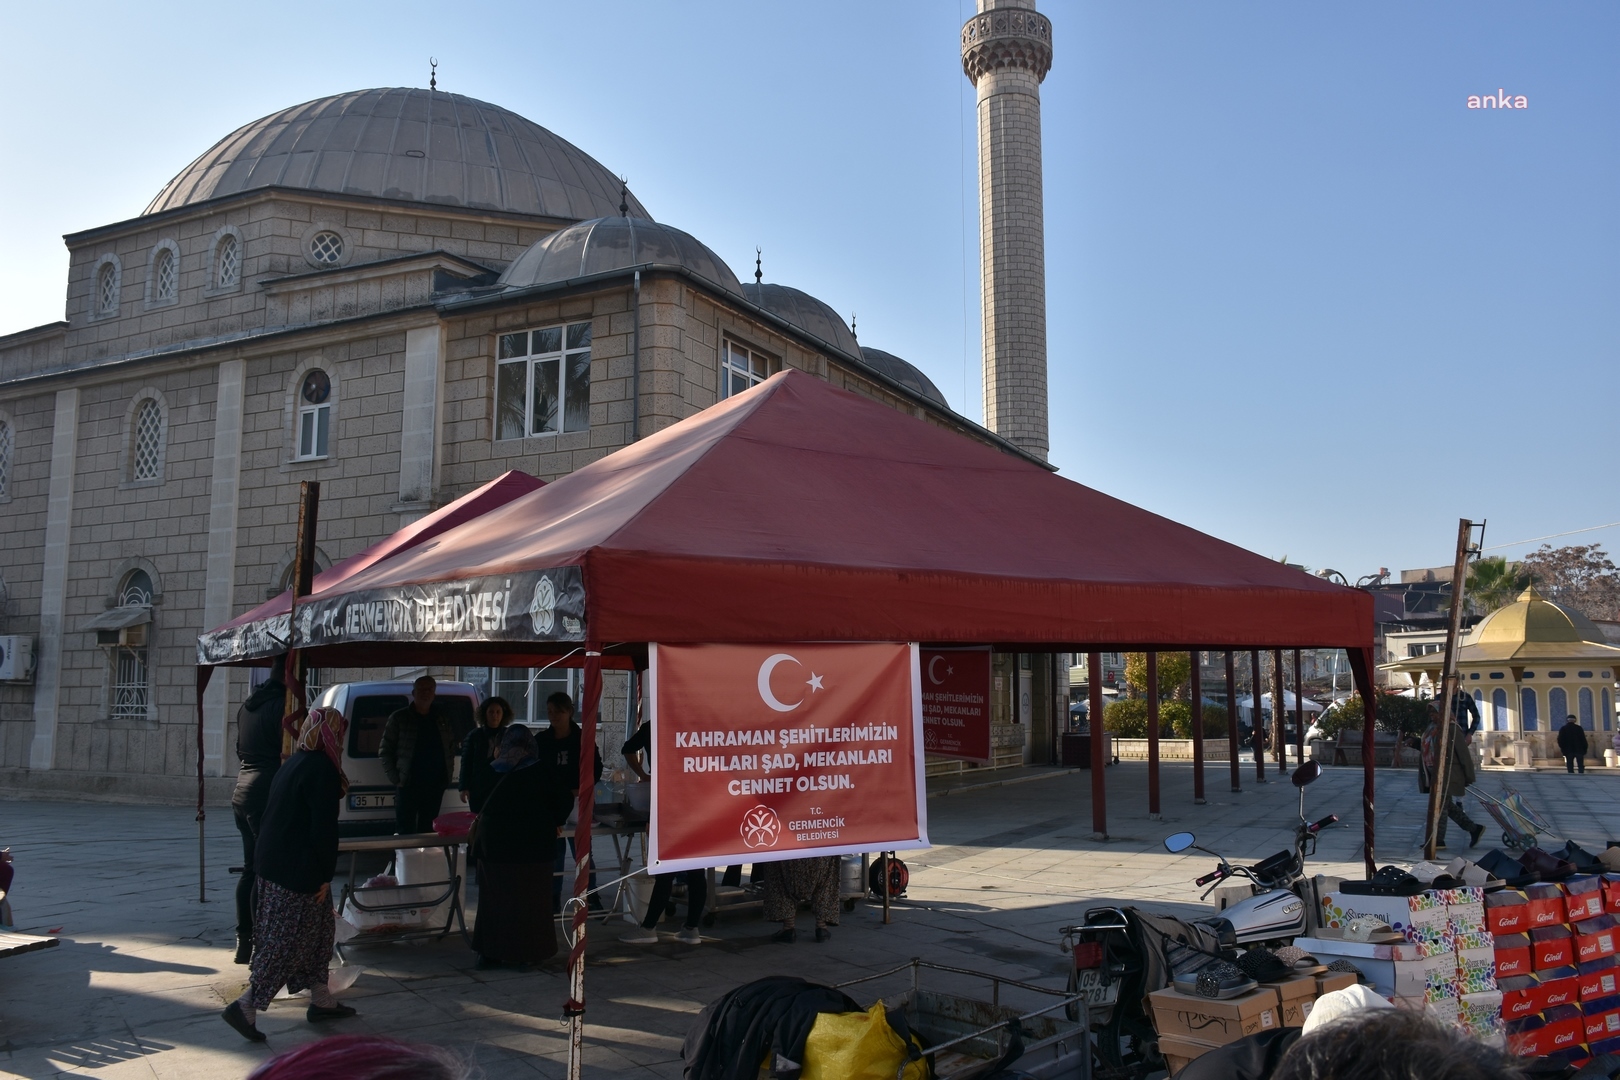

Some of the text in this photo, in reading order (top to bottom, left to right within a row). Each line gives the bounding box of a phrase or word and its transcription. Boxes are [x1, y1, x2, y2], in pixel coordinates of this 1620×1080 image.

[323, 610, 343, 637] T.C.
[415, 579, 511, 633] BELEDİYESİ
[935, 691, 984, 704] ŞEHİTLERİMİZİN
[944, 705, 981, 716] MEKANLARI
[923, 716, 965, 727] ENNET OLSUN.
[675, 721, 898, 749] KAHRAMAN ŞEHİTLERİMİZİN
[683, 748, 892, 774] RUHLARI ŞAD, MEKANLARI
[727, 774, 855, 796] CENNET OLSUN.
[356, 796, 367, 806] 35
[374, 796, 385, 806] TY
[810, 807, 824, 815] T.C.
[788, 815, 845, 831] GERMENCİK
[796, 829, 839, 841] BELEDİYESİ
[1083, 973, 1097, 988] 09
